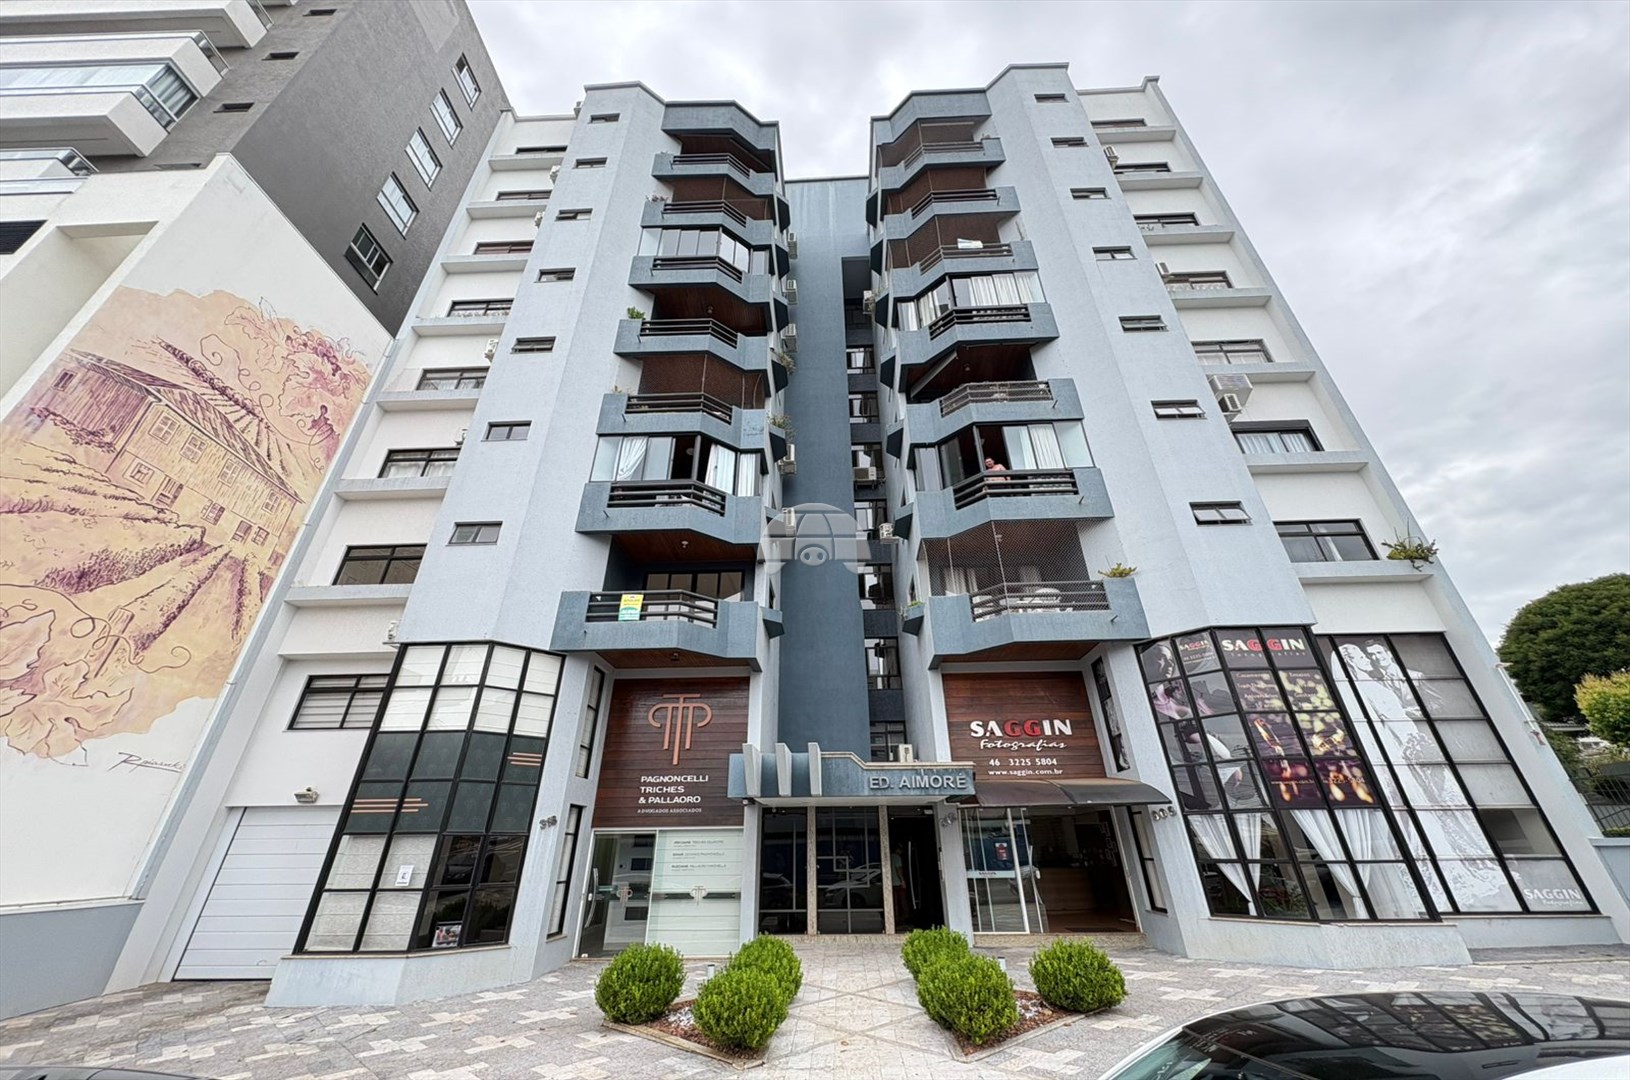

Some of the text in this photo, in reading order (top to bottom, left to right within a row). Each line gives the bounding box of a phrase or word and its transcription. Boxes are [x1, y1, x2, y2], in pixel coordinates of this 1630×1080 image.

[1221, 638, 1305, 652] SAGGIN
[970, 719, 1073, 737] SAGGIN
[980, 739, 1067, 751] Fotografias
[1009, 758, 1031, 766] 3225
[869, 773, 967, 788] ED. AIMORÉ
[1523, 888, 1581, 900] SAGGIN
